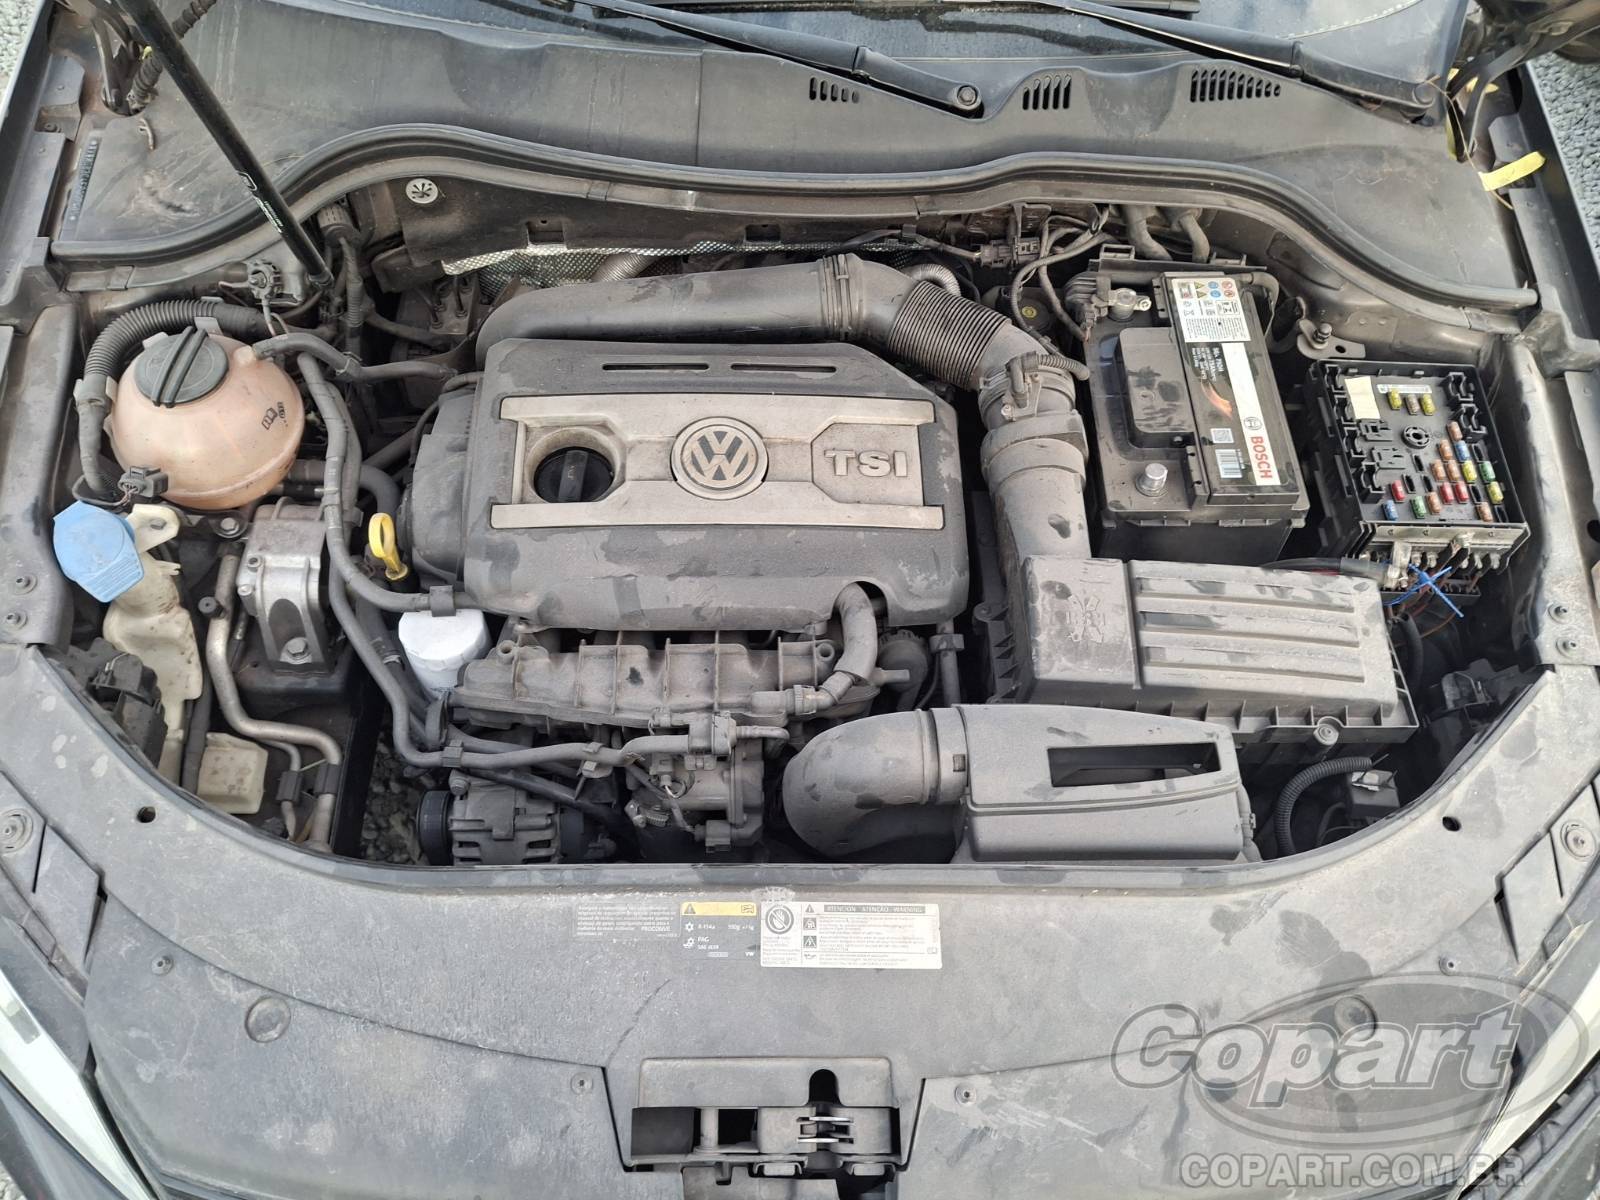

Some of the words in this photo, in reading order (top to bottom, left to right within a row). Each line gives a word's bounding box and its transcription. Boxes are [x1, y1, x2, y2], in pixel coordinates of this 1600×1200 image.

[680, 424, 758, 490] VW
[823, 450, 908, 477] TSI
[1250, 436, 1273, 478] BOSCH
